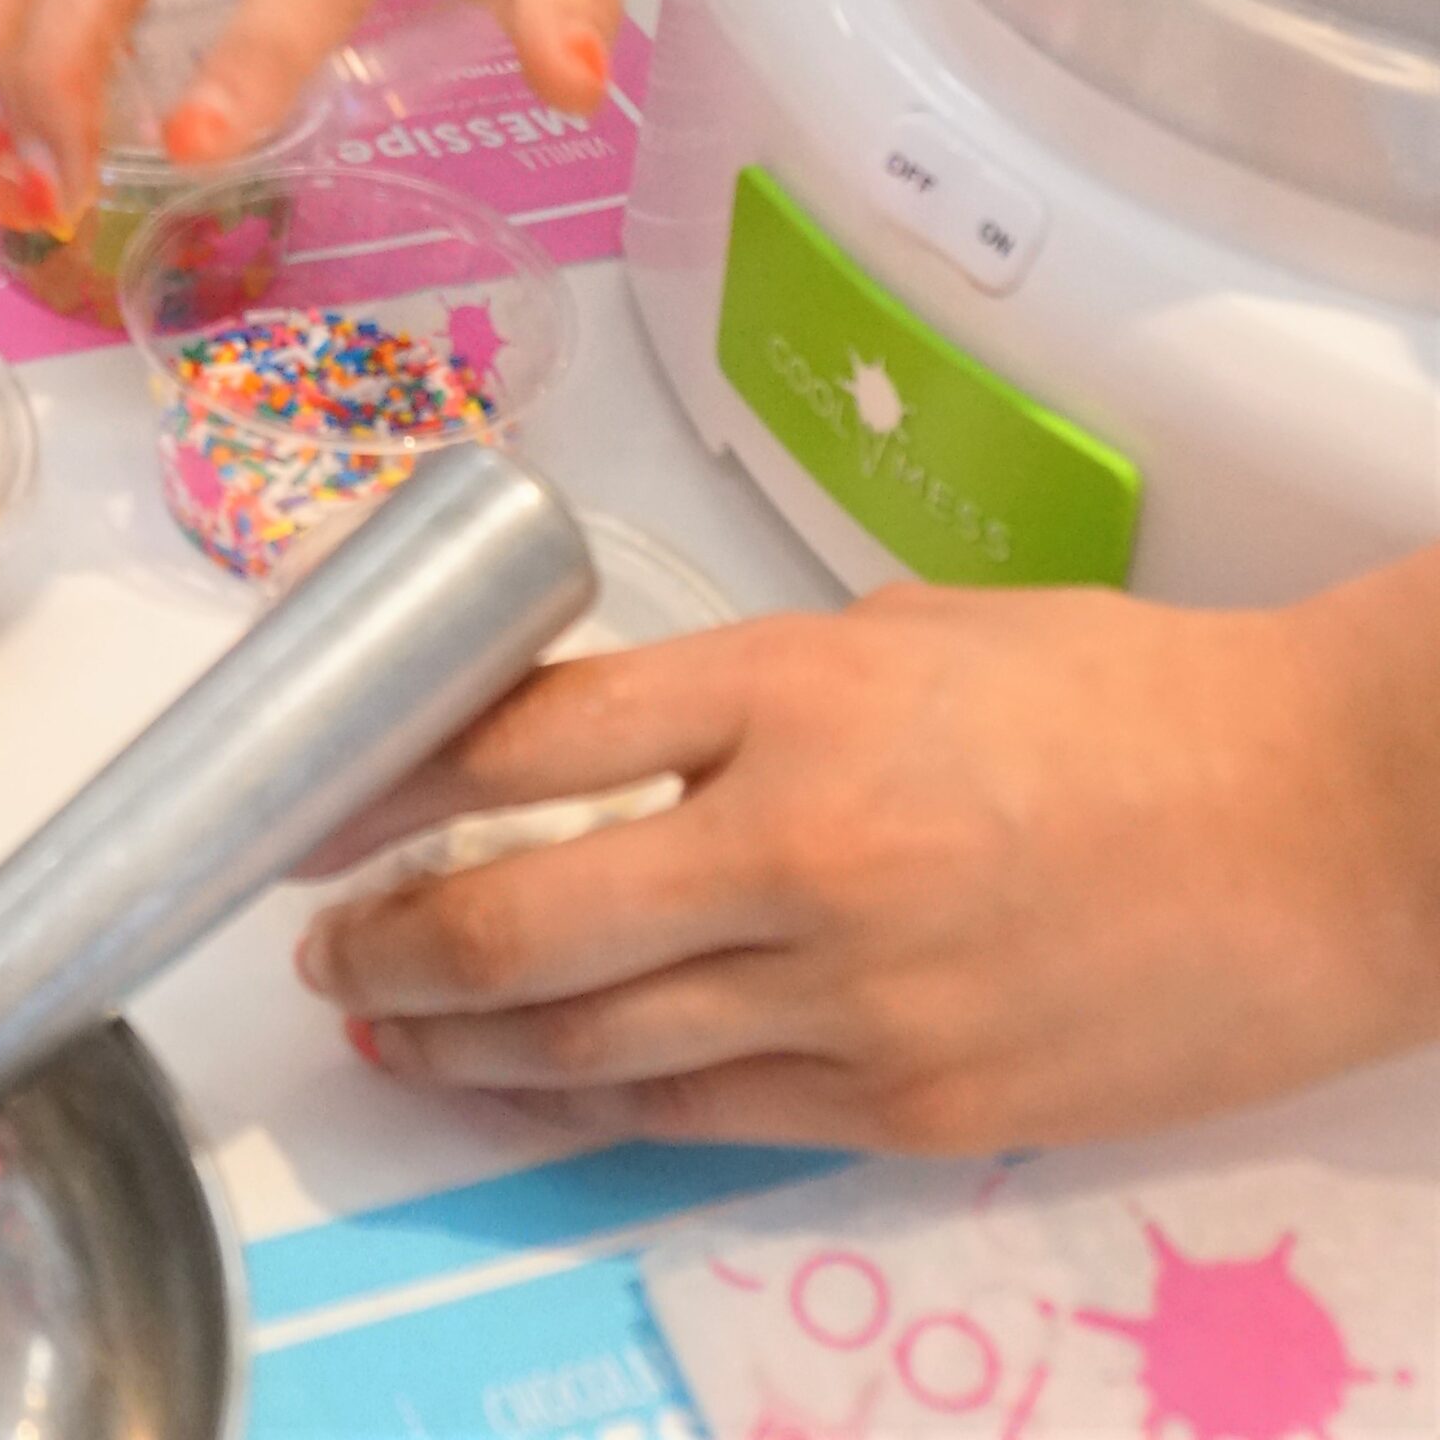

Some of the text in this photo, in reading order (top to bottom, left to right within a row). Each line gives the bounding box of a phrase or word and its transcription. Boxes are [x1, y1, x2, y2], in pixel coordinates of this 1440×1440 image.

[510, 136, 619, 173] VANILLA
[885, 150, 938, 193] OFF
[978, 219, 1016, 259] ON
[891, 449, 1012, 564] MESS
